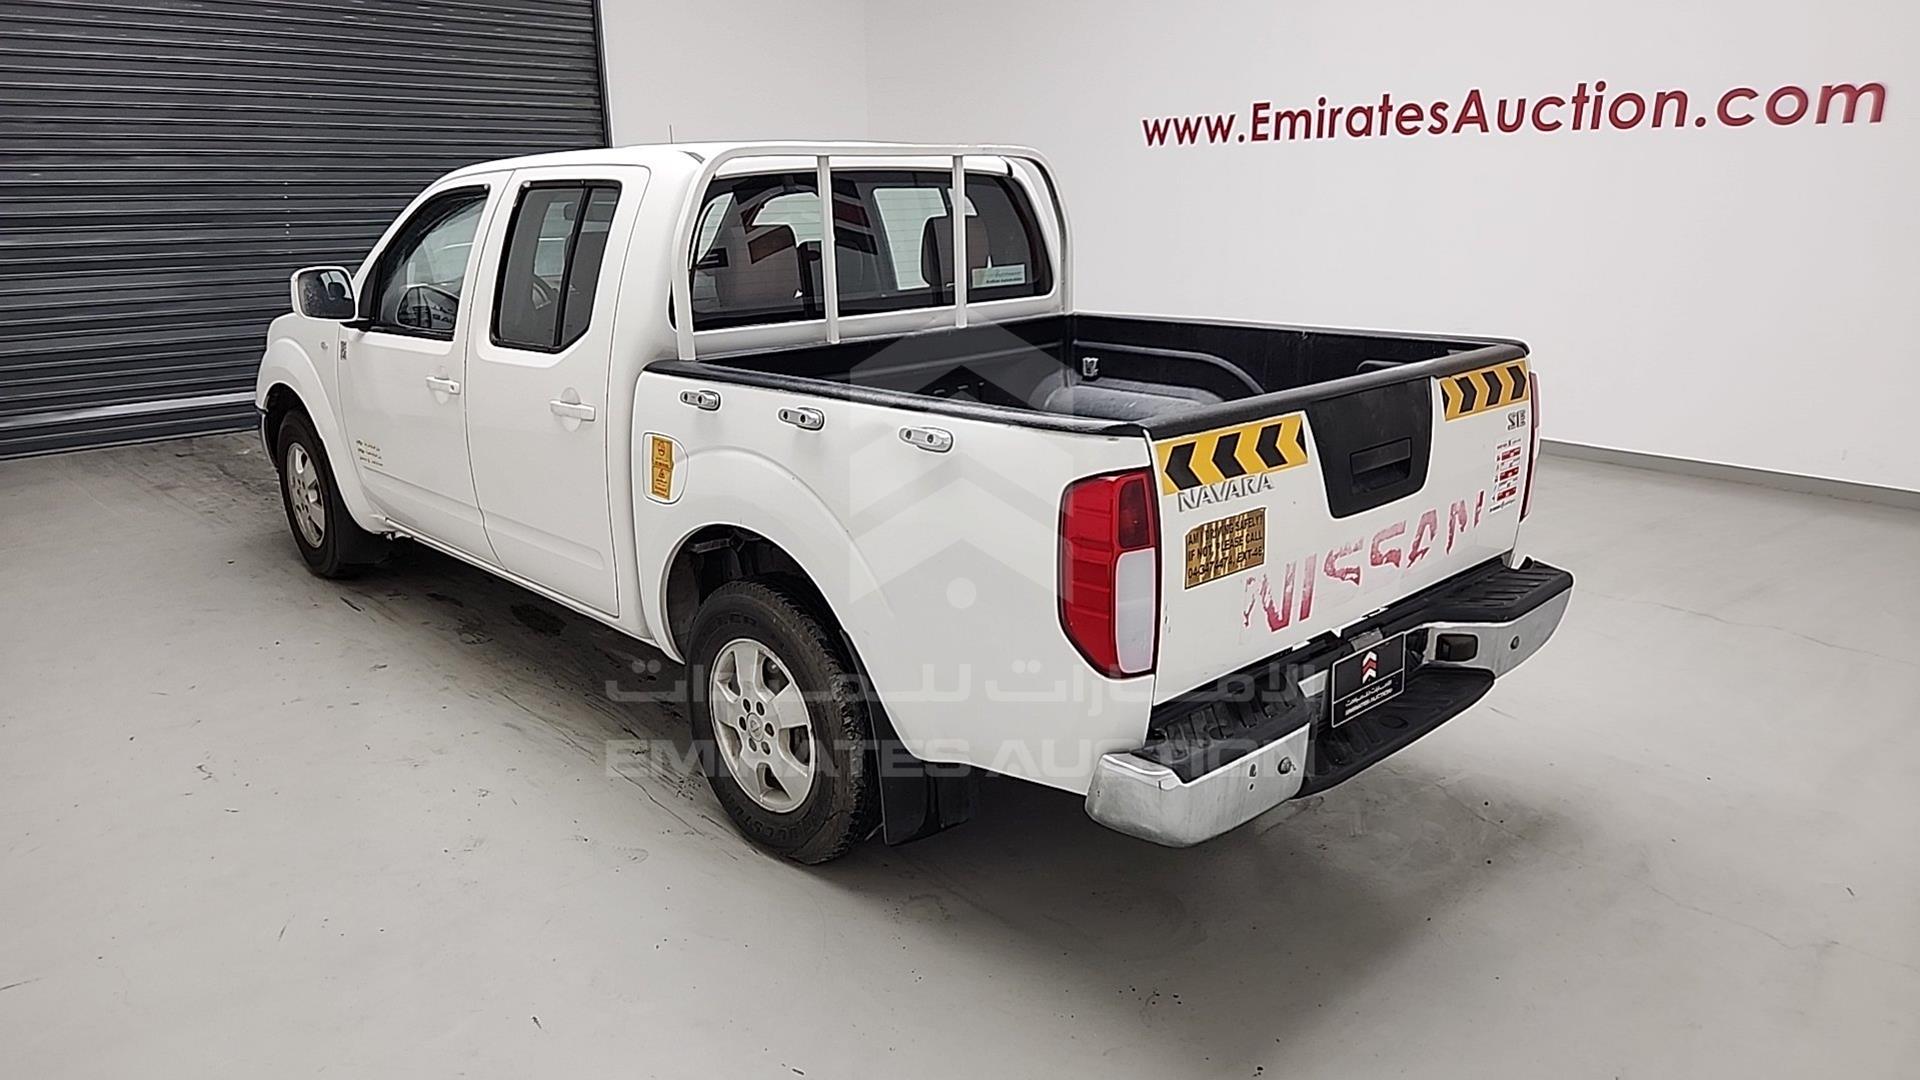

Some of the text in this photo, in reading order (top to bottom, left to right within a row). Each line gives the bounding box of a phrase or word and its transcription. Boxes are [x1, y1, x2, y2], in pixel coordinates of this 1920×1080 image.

[1142, 82, 1886, 147] www.EmiratesAuction.com
[1178, 473, 1274, 512] NAVARA
[1198, 543, 1212, 560] NOT
[1215, 535, 1244, 554] PLEASE
[1246, 527, 1263, 544] CALL
